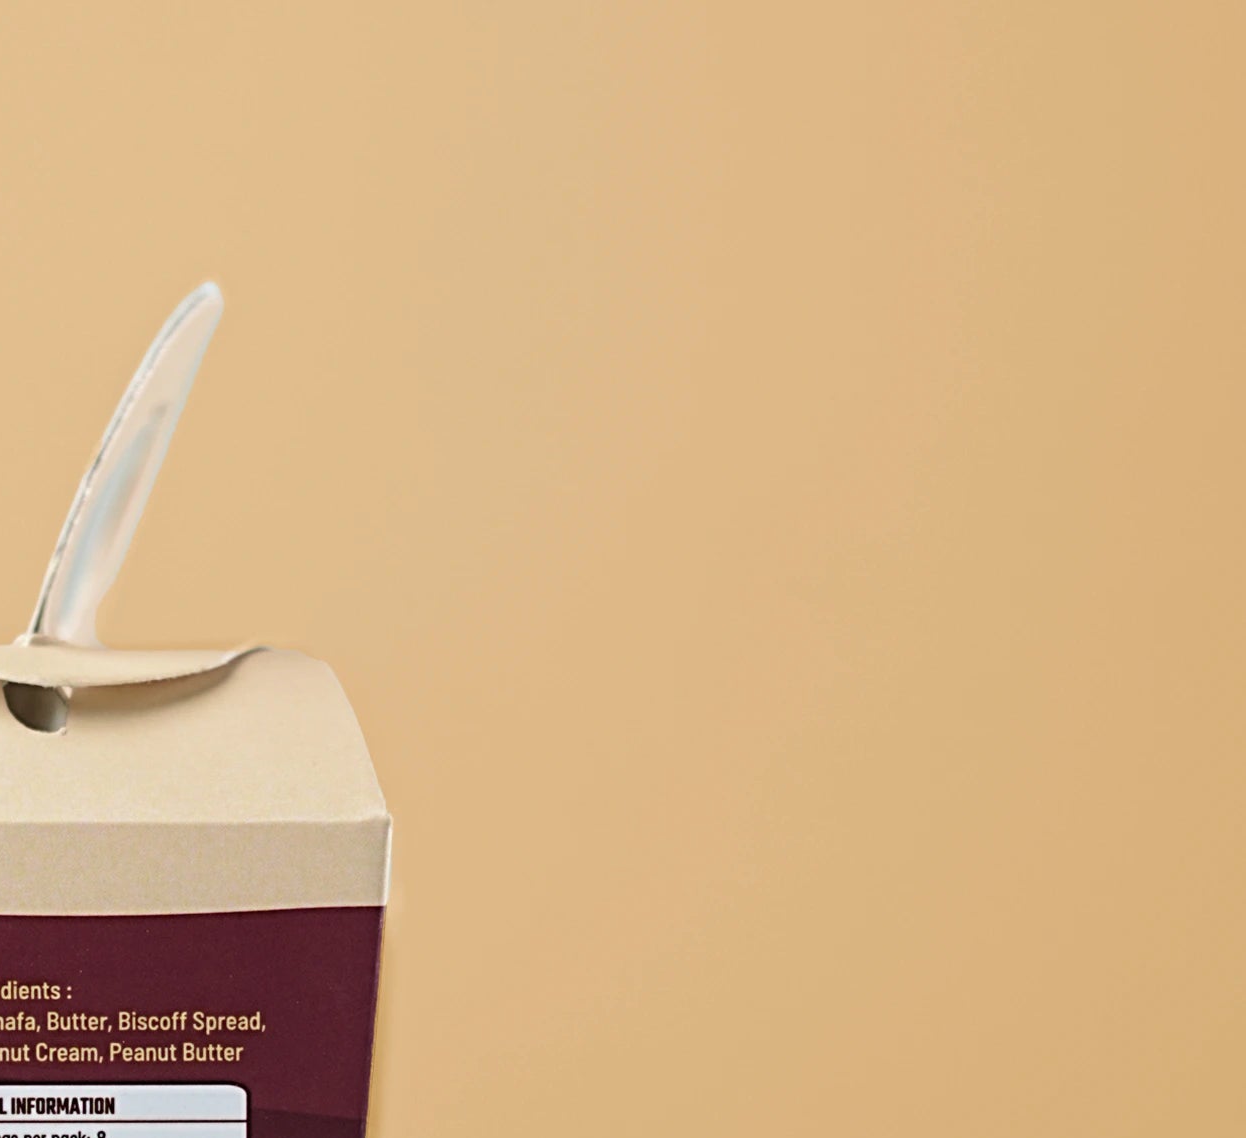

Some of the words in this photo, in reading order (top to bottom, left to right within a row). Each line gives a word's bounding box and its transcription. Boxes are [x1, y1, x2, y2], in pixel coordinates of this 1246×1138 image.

[47, 1011, 113, 1033] Butter,
[118, 1011, 188, 1031] Biscoff
[192, 1011, 266, 1036] Spread,
[35, 1042, 104, 1064] Cream,
[109, 1042, 177, 1062] Peanut
[182, 1042, 244, 1062] Butter
[10, 1096, 116, 1115] INFORMATION
